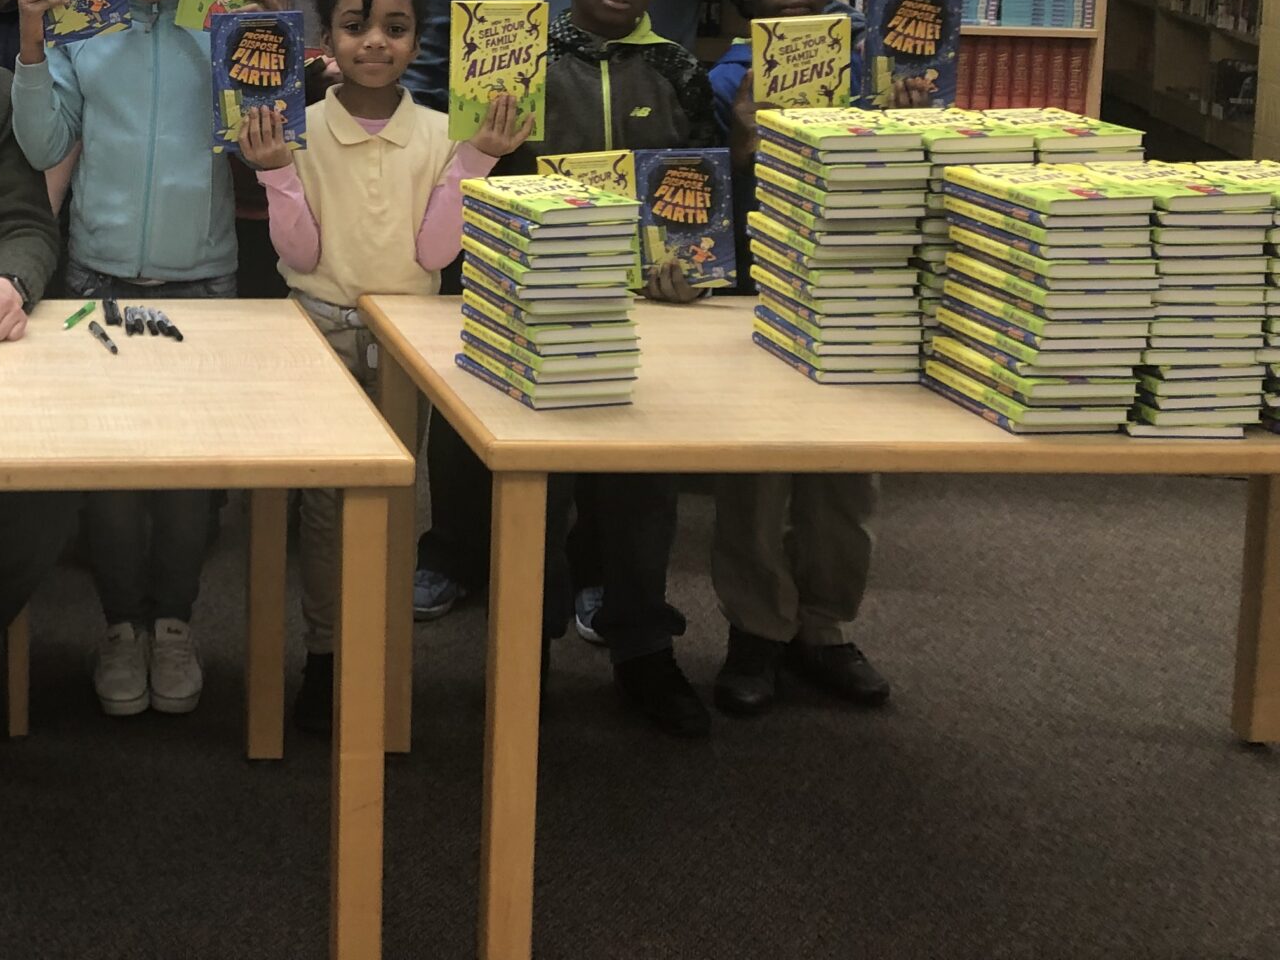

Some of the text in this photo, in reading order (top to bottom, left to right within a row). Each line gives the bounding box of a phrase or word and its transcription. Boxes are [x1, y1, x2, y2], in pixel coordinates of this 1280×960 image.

[243, 31, 284, 43] PROPERLY
[478, 20, 525, 40] SELL YOUR
[887, 15, 942, 40] PLANET
[240, 39, 279, 52] DISPOSE
[485, 33, 518, 49] FAMILY
[778, 35, 827, 56] SELL YOUR
[883, 30, 936, 55] EARTH
[231, 47, 285, 70] PLANET
[464, 44, 534, 83] ALIENS
[786, 48, 819, 64] FAMILY
[228, 63, 282, 87] EARTH
[766, 58, 836, 98] ALIENS
[588, 171, 612, 186] YOUR
[653, 184, 712, 208] PLANET
[651, 200, 709, 224] EARTH
